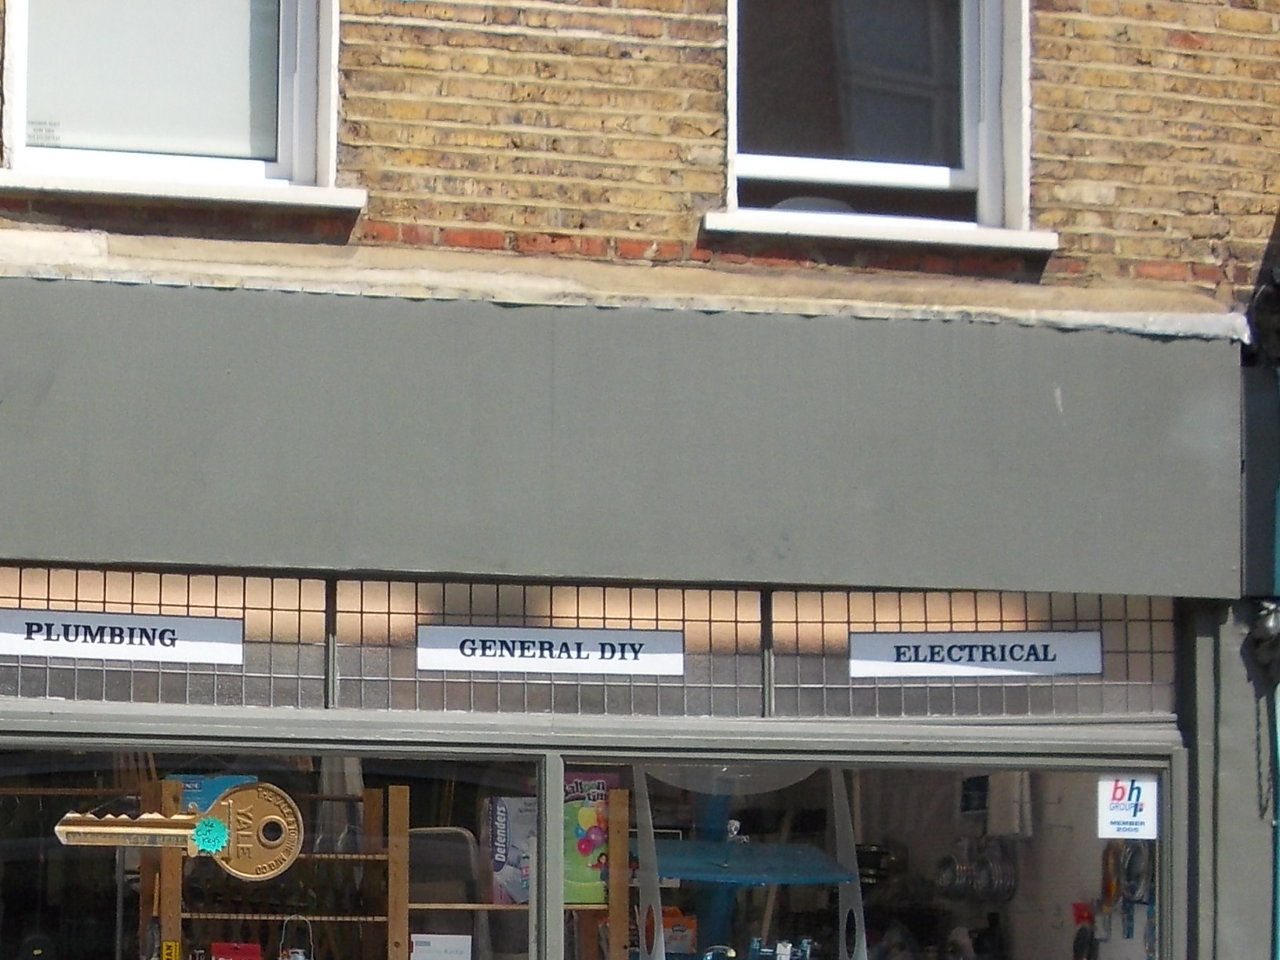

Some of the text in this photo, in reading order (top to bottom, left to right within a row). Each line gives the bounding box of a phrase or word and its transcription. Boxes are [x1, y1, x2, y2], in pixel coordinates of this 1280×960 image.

[24, 621, 179, 648] PLUMBING
[459, 638, 645, 661] GENERAL DIY
[894, 643, 1057, 663] ELECTRICAL
[236, 805, 255, 860] YALE
[494, 805, 507, 862] Defenders
